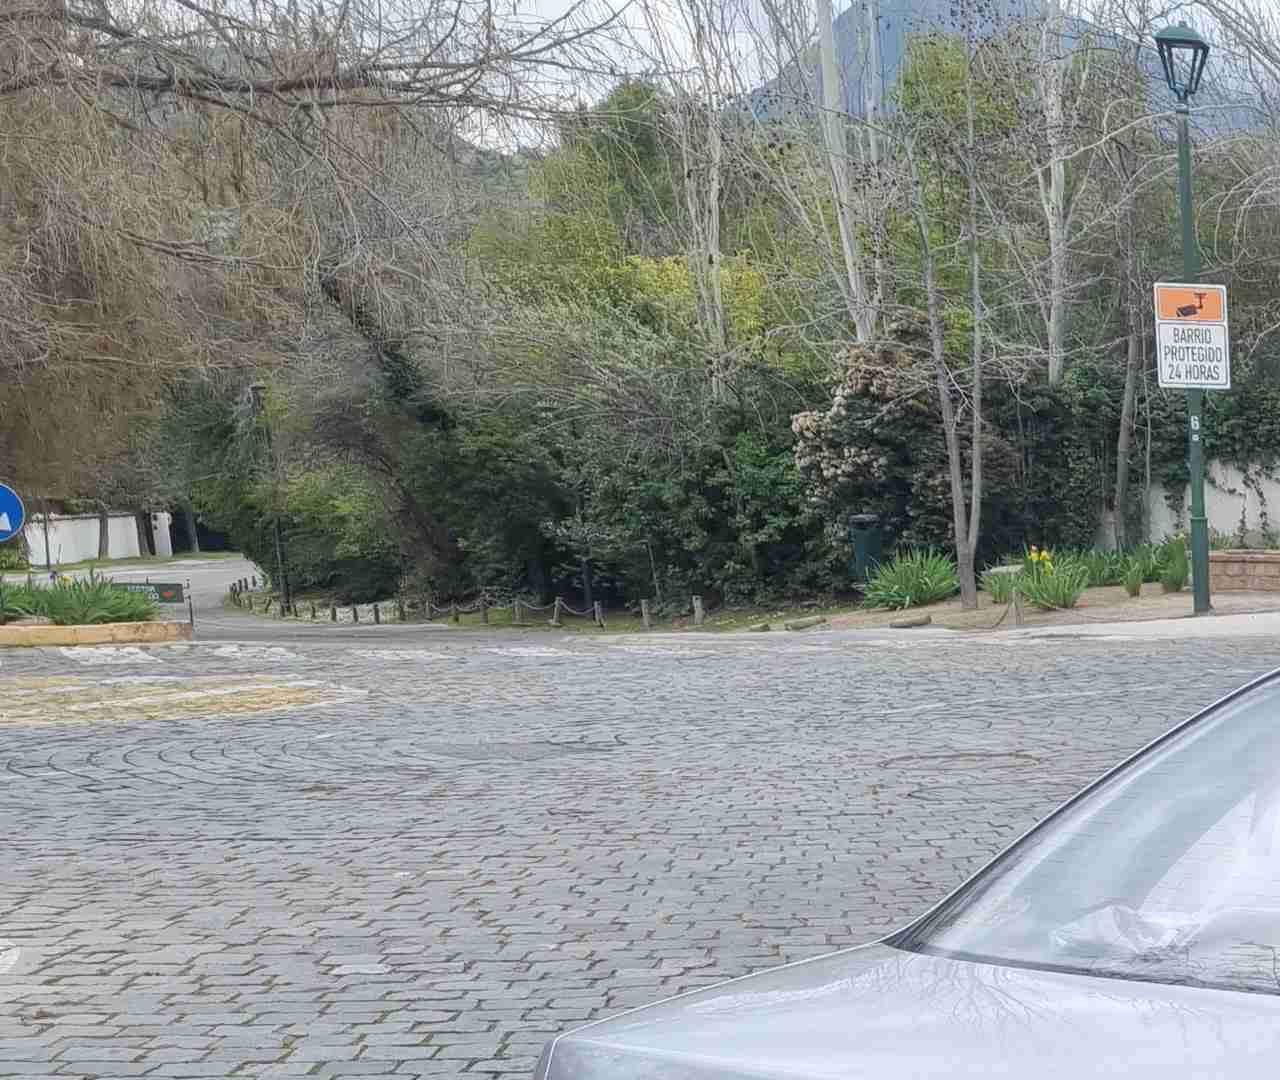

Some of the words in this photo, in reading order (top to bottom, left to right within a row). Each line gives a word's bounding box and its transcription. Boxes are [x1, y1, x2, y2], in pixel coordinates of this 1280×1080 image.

[1173, 327, 1212, 344] BARRIO
[1163, 345, 1222, 362] PROTEGIDO
[1168, 364, 1182, 380] 24
[1185, 364, 1220, 380] HORAS
